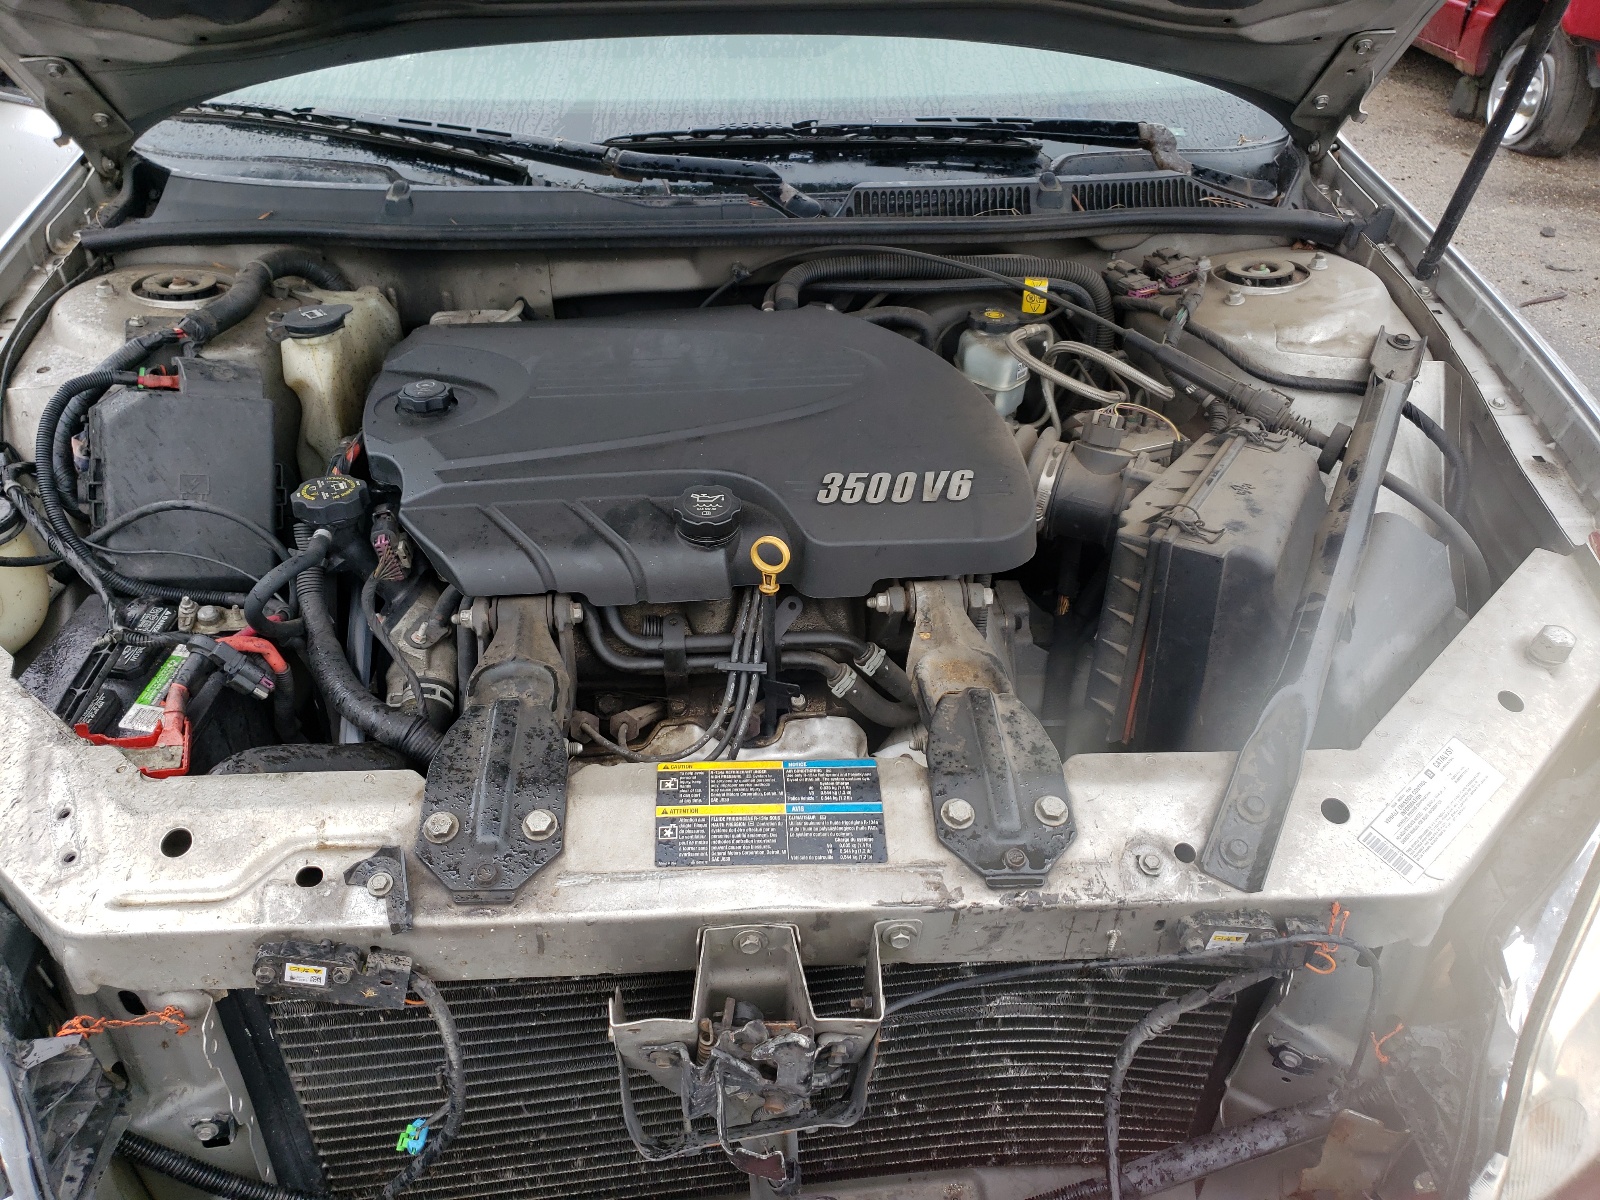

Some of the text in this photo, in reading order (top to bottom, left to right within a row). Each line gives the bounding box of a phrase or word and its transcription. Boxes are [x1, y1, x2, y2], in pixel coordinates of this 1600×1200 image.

[816, 470, 974, 504] 3500 V6
[1432, 745, 1454, 769] CATALYST
